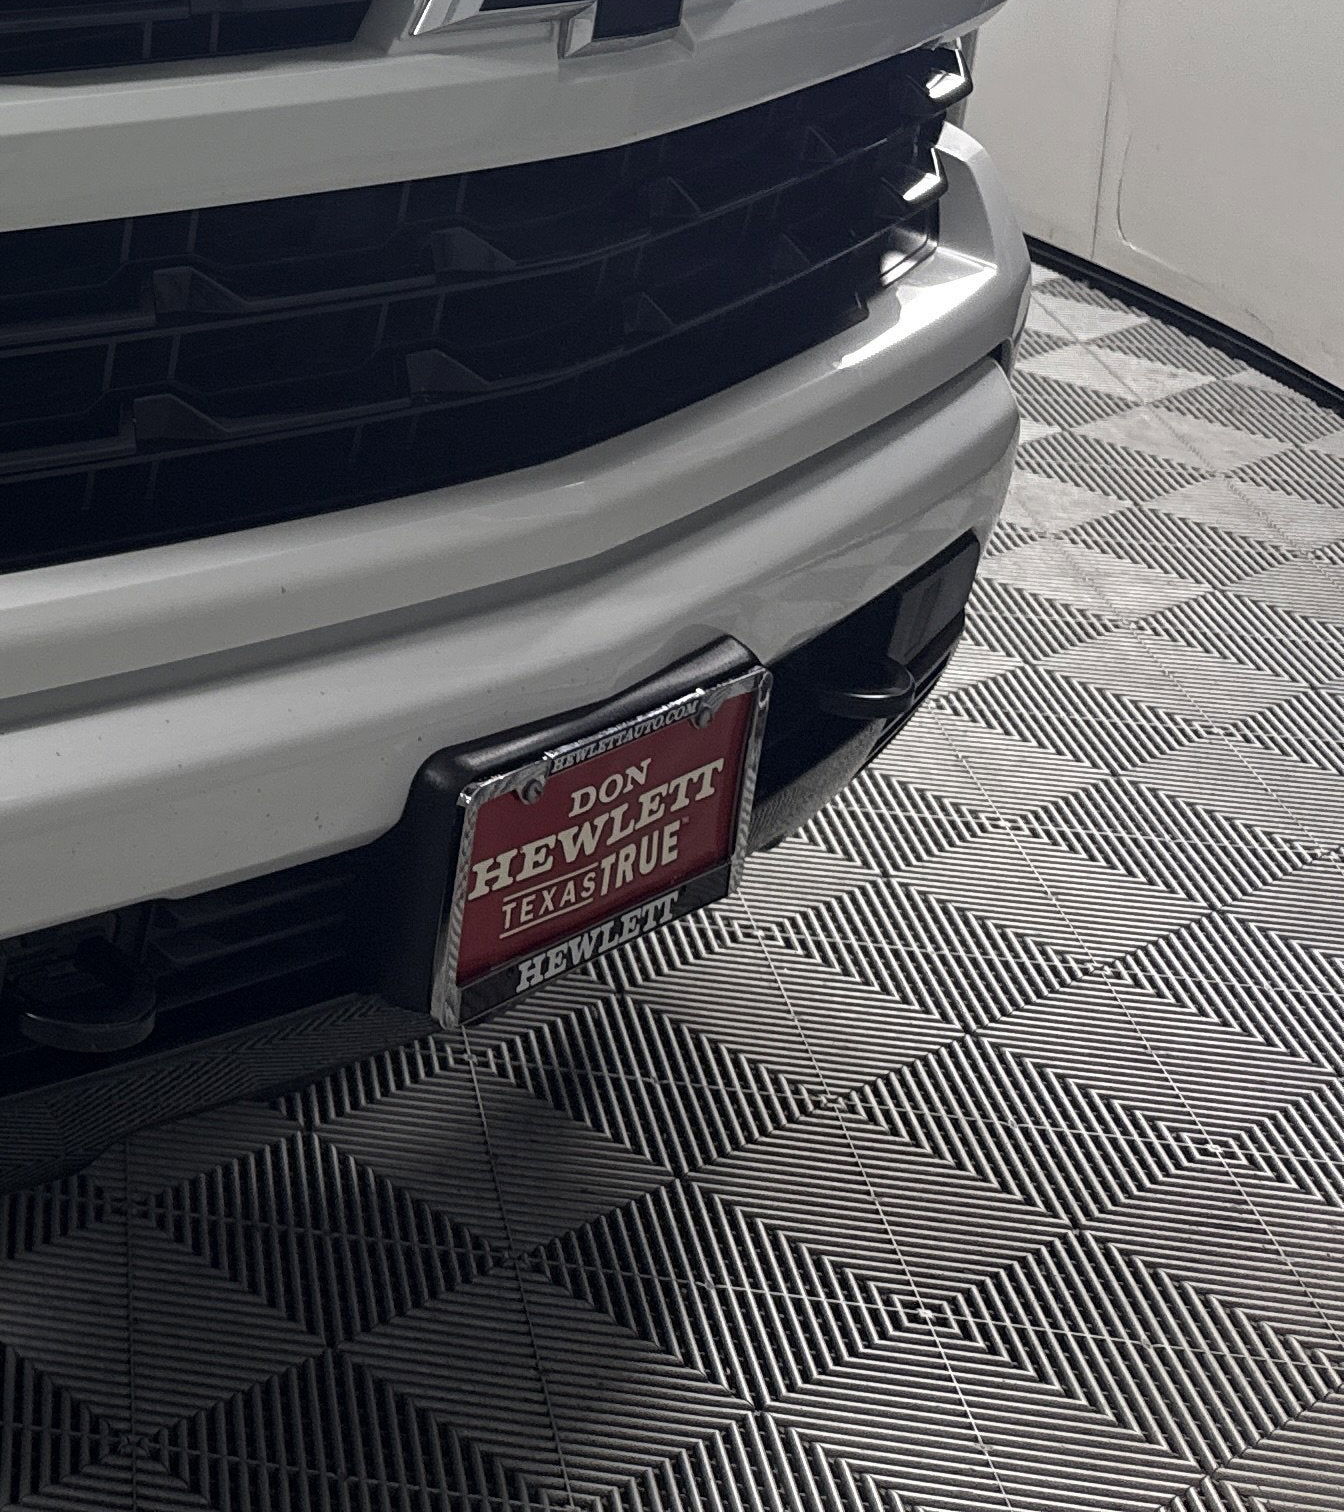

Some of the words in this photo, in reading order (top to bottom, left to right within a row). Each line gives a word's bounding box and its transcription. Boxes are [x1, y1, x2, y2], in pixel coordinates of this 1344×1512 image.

[551, 699, 699, 774] HEWLETTAUTO.COM
[467, 757, 725, 901] HEWLETT
[568, 757, 652, 819] DON
[516, 890, 679, 993] HEWLETT
